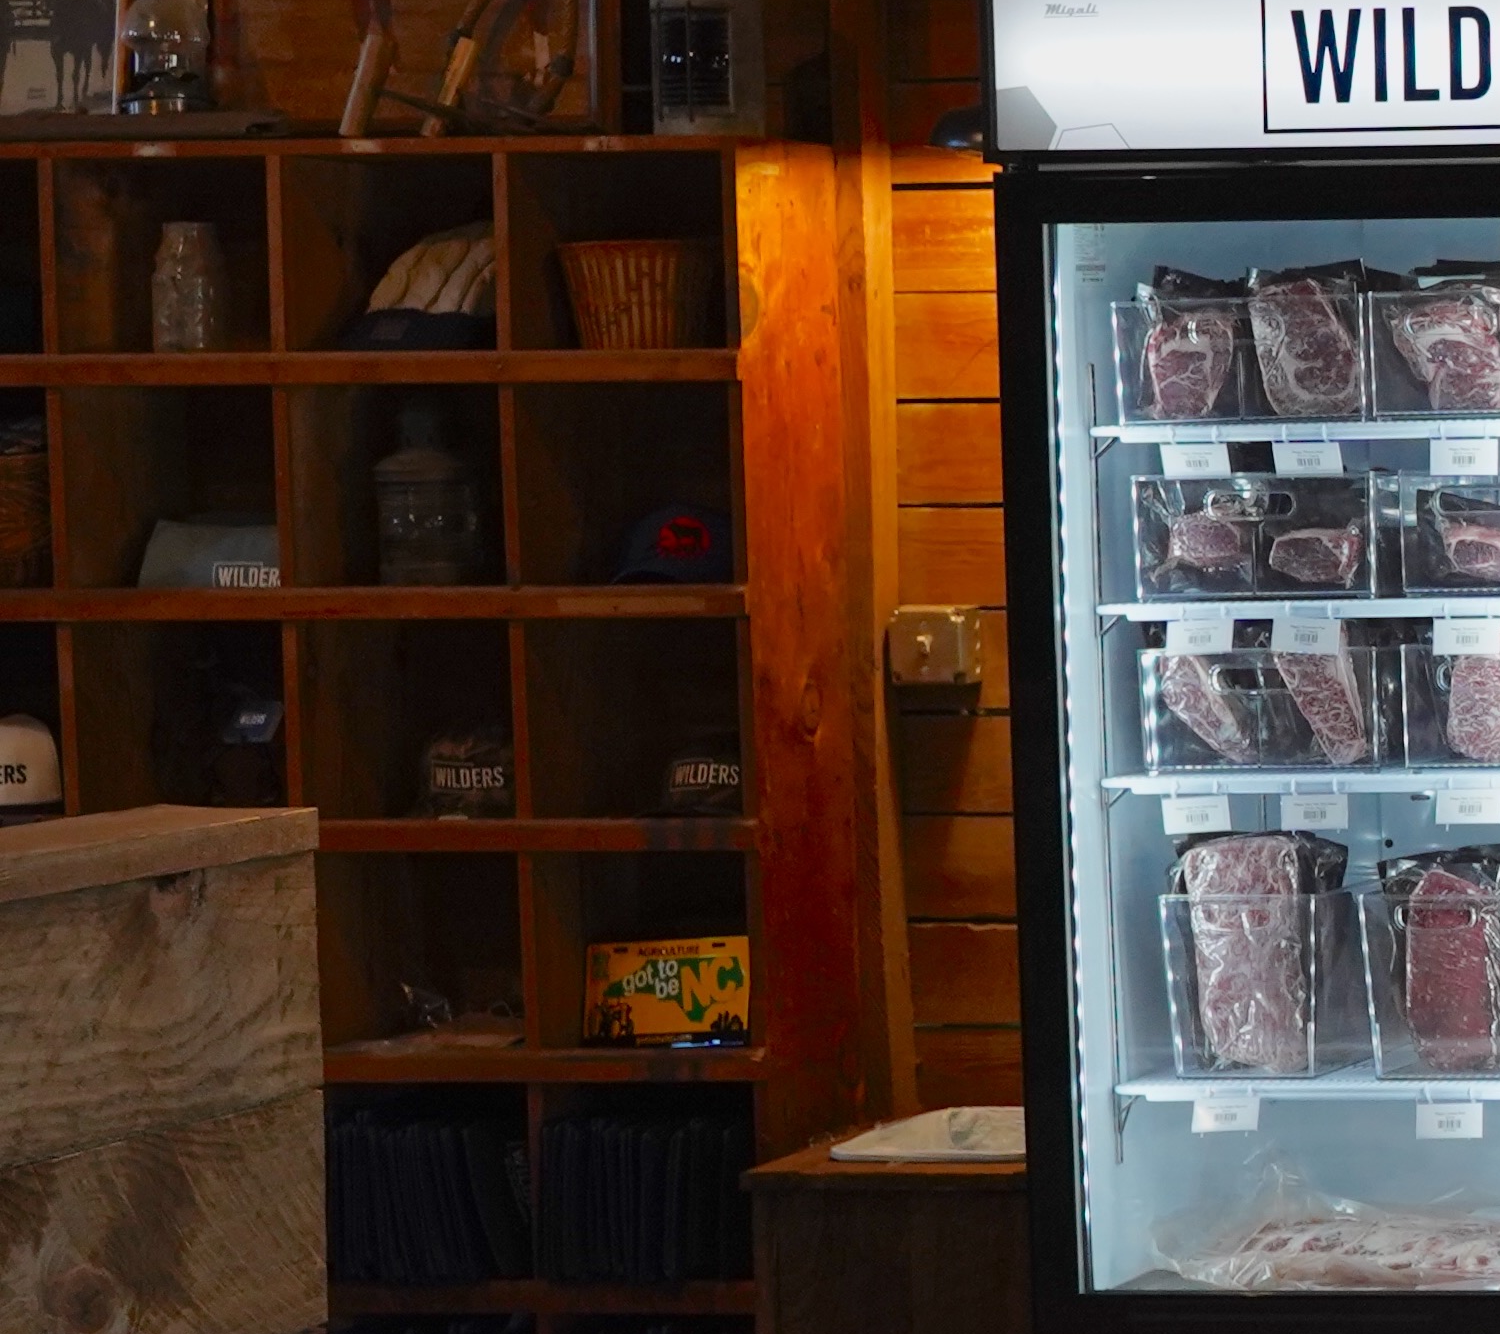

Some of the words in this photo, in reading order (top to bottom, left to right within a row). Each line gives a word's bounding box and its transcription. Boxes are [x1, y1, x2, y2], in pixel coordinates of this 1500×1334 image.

[217, 564, 282, 586] WILDER
[434, 764, 504, 788] WILDERS
[672, 762, 740, 786] WILDERS
[622, 966, 655, 996] got
[657, 959, 679, 980] to
[655, 977, 680, 999] be
[680, 958, 737, 1012] NC
